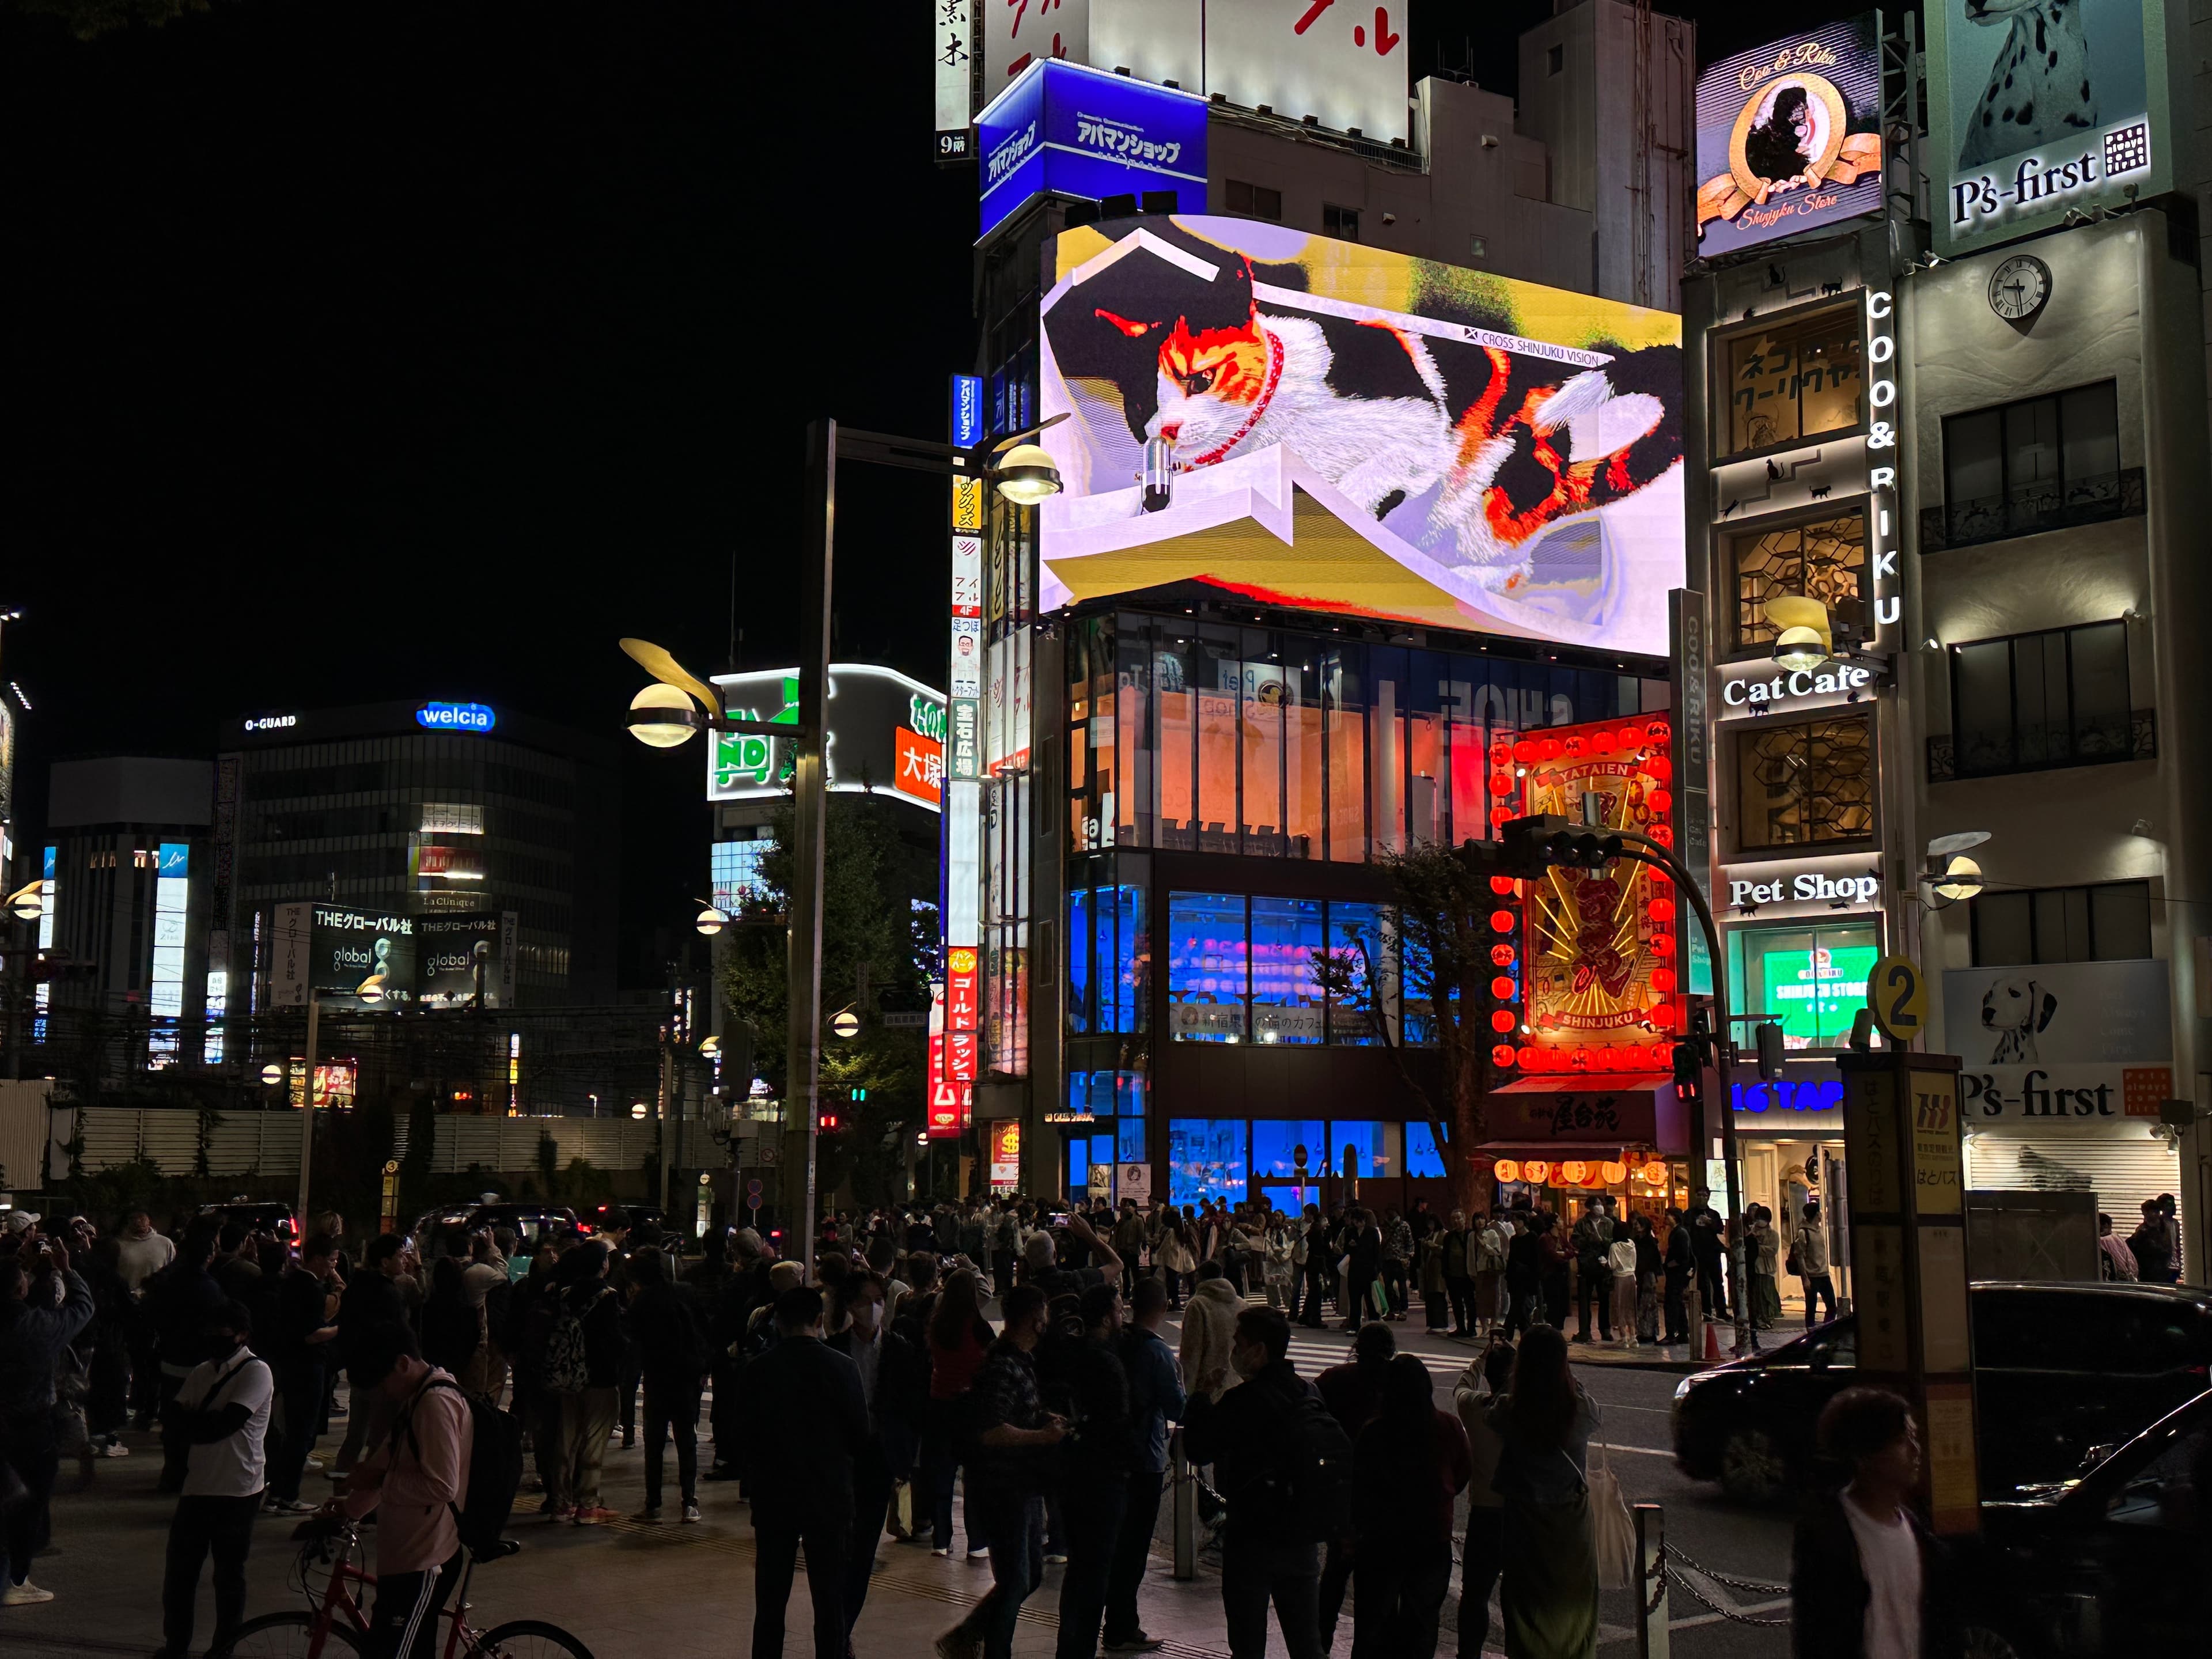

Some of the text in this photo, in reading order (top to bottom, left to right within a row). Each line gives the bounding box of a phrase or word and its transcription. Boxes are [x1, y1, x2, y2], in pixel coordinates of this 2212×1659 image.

[1774, 49, 1791, 71] &
[1793, 43, 1836, 66] Riku
[988, 120, 1036, 182] アパマンショップ
[1077, 122, 1181, 164] アパマンショップ
[1482, 332, 1599, 366] CROSS SHINJUKU VISION
[960, 379, 971, 441] アパマンショップ
[1866, 291, 1900, 626] COO & RIKU
[960, 605, 973, 616] 4F
[1687, 615, 1700, 673] COO
[1723, 677, 1785, 706] Cat
[245, 715, 296, 731] O-GUARD
[423, 703, 488, 727] welcia
[956, 704, 974, 777] 宝石広場
[1689, 699, 1705, 766] RIKU
[1559, 764, 1628, 782] YATAIEN
[1729, 873, 1878, 907] Pet Shop
[315, 910, 414, 935] THEグローバル社
[421, 921, 497, 933] THEグローバル社
[334, 946, 372, 972] global
[427, 950, 469, 977] global
[1888, 965, 1918, 1027] 2
[1562, 1012, 1634, 1029] SHINJUKU
[1917, 1169, 1956, 1185] はとバス
